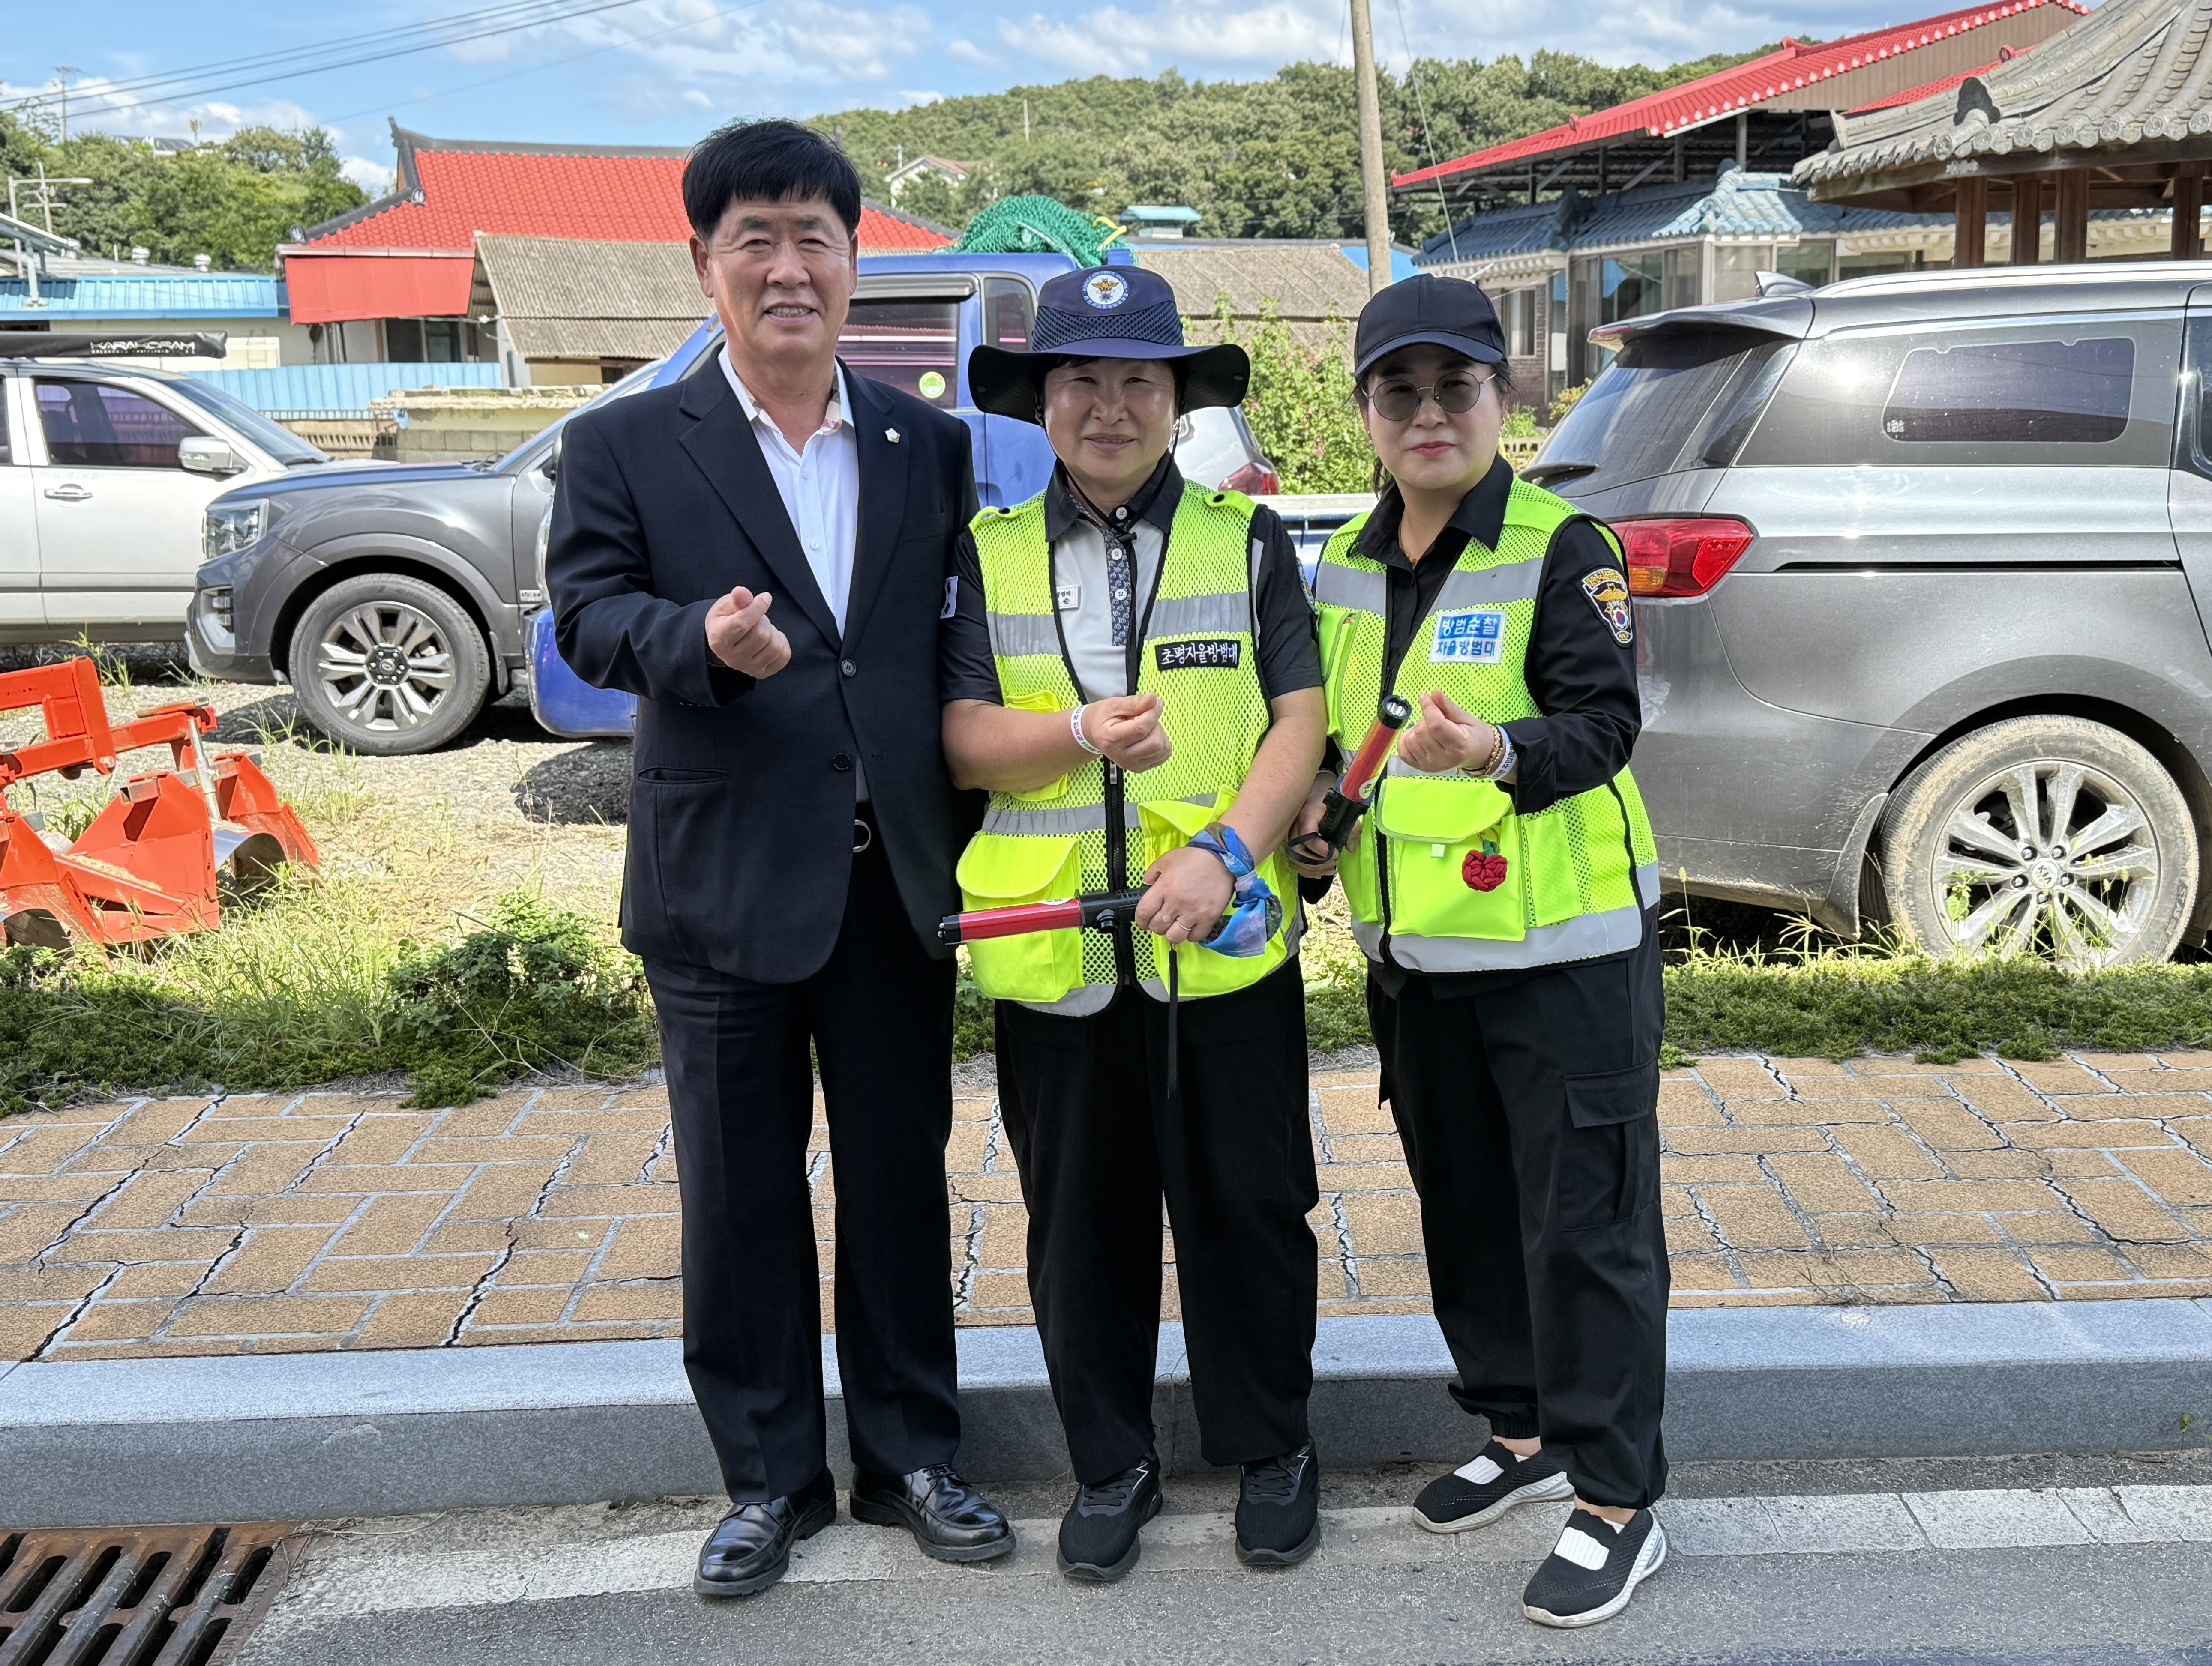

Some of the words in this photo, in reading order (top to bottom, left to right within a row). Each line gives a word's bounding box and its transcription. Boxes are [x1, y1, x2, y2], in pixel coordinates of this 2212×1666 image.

[90, 341, 195, 350] KARAKORAM
[1442, 616, 1498, 637] 방범순찰
[1160, 642, 1238, 665] 초평자율방범대
[1436, 640, 1496, 657] 자율방범대
[2038, 865, 2052, 885] KIA
